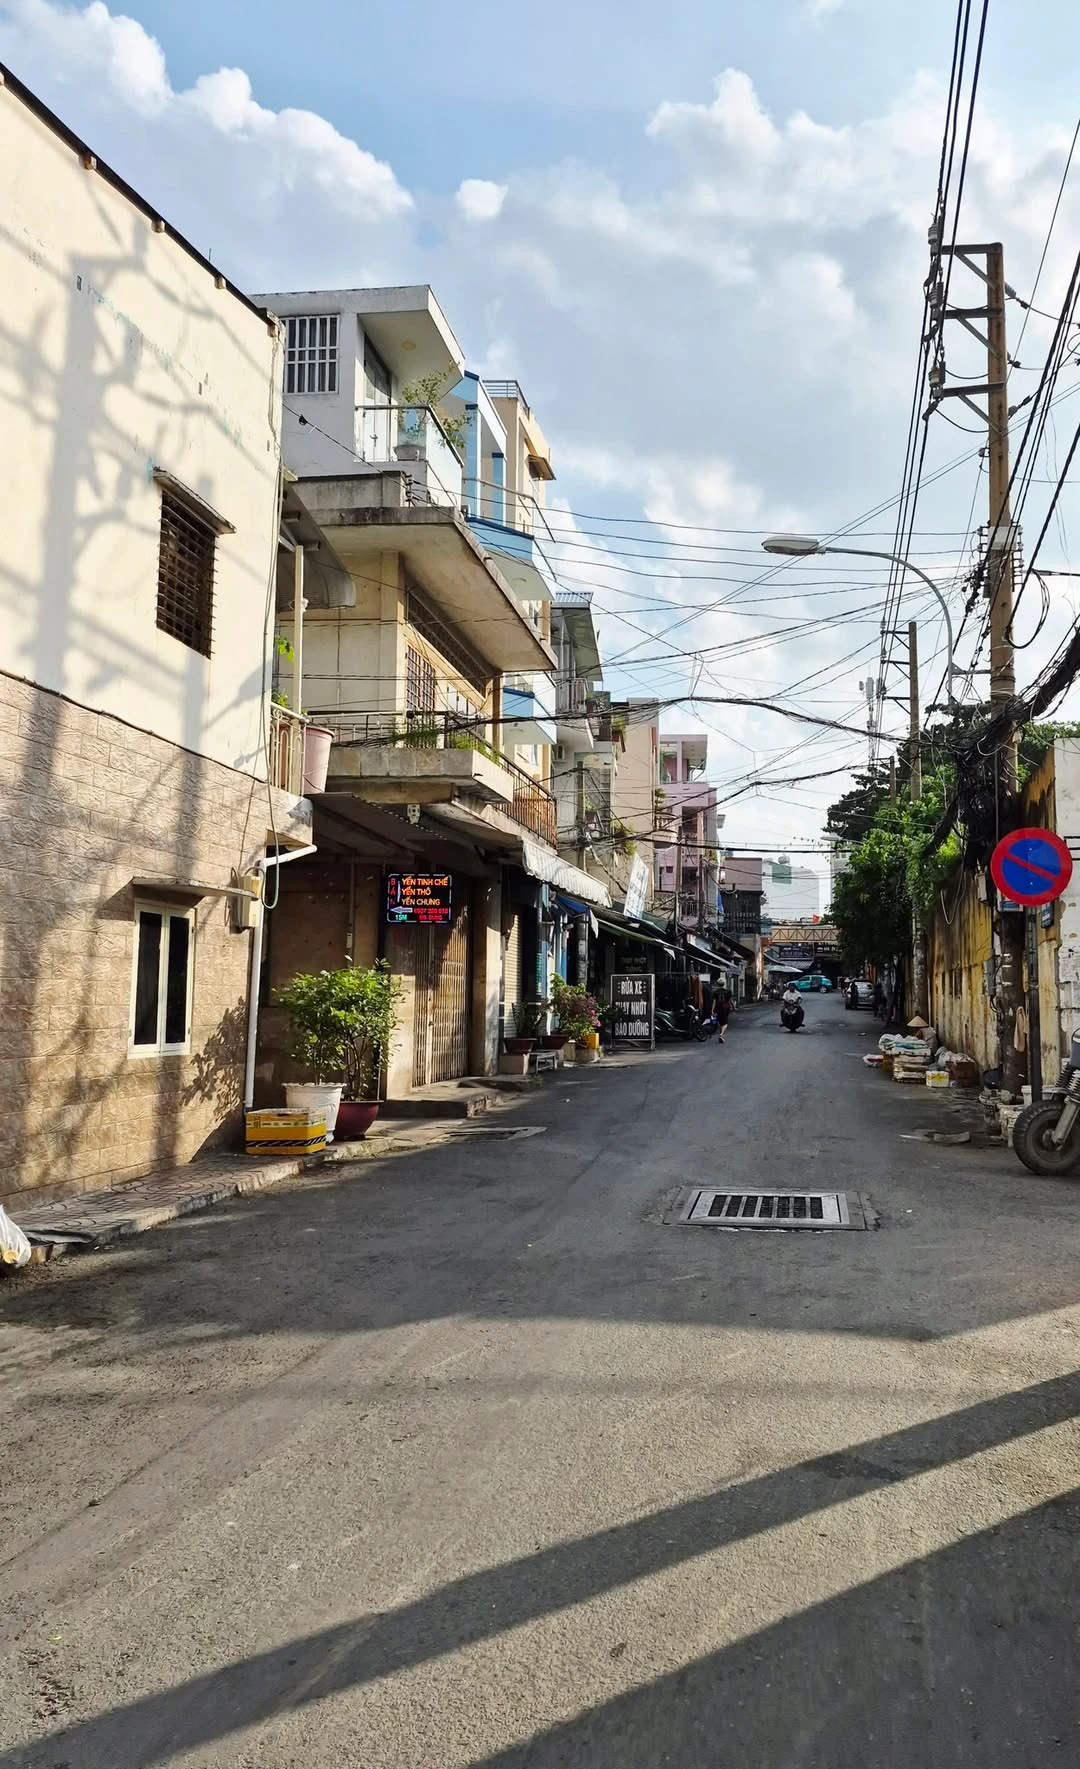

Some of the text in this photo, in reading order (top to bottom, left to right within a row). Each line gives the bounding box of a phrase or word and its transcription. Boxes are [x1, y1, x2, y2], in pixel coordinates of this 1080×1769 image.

[402, 876, 416, 886] YẾN
[402, 887, 416, 896] YẾN
[401, 896, 416, 906] YẾN
[621, 976, 643, 995] RỬA XE
